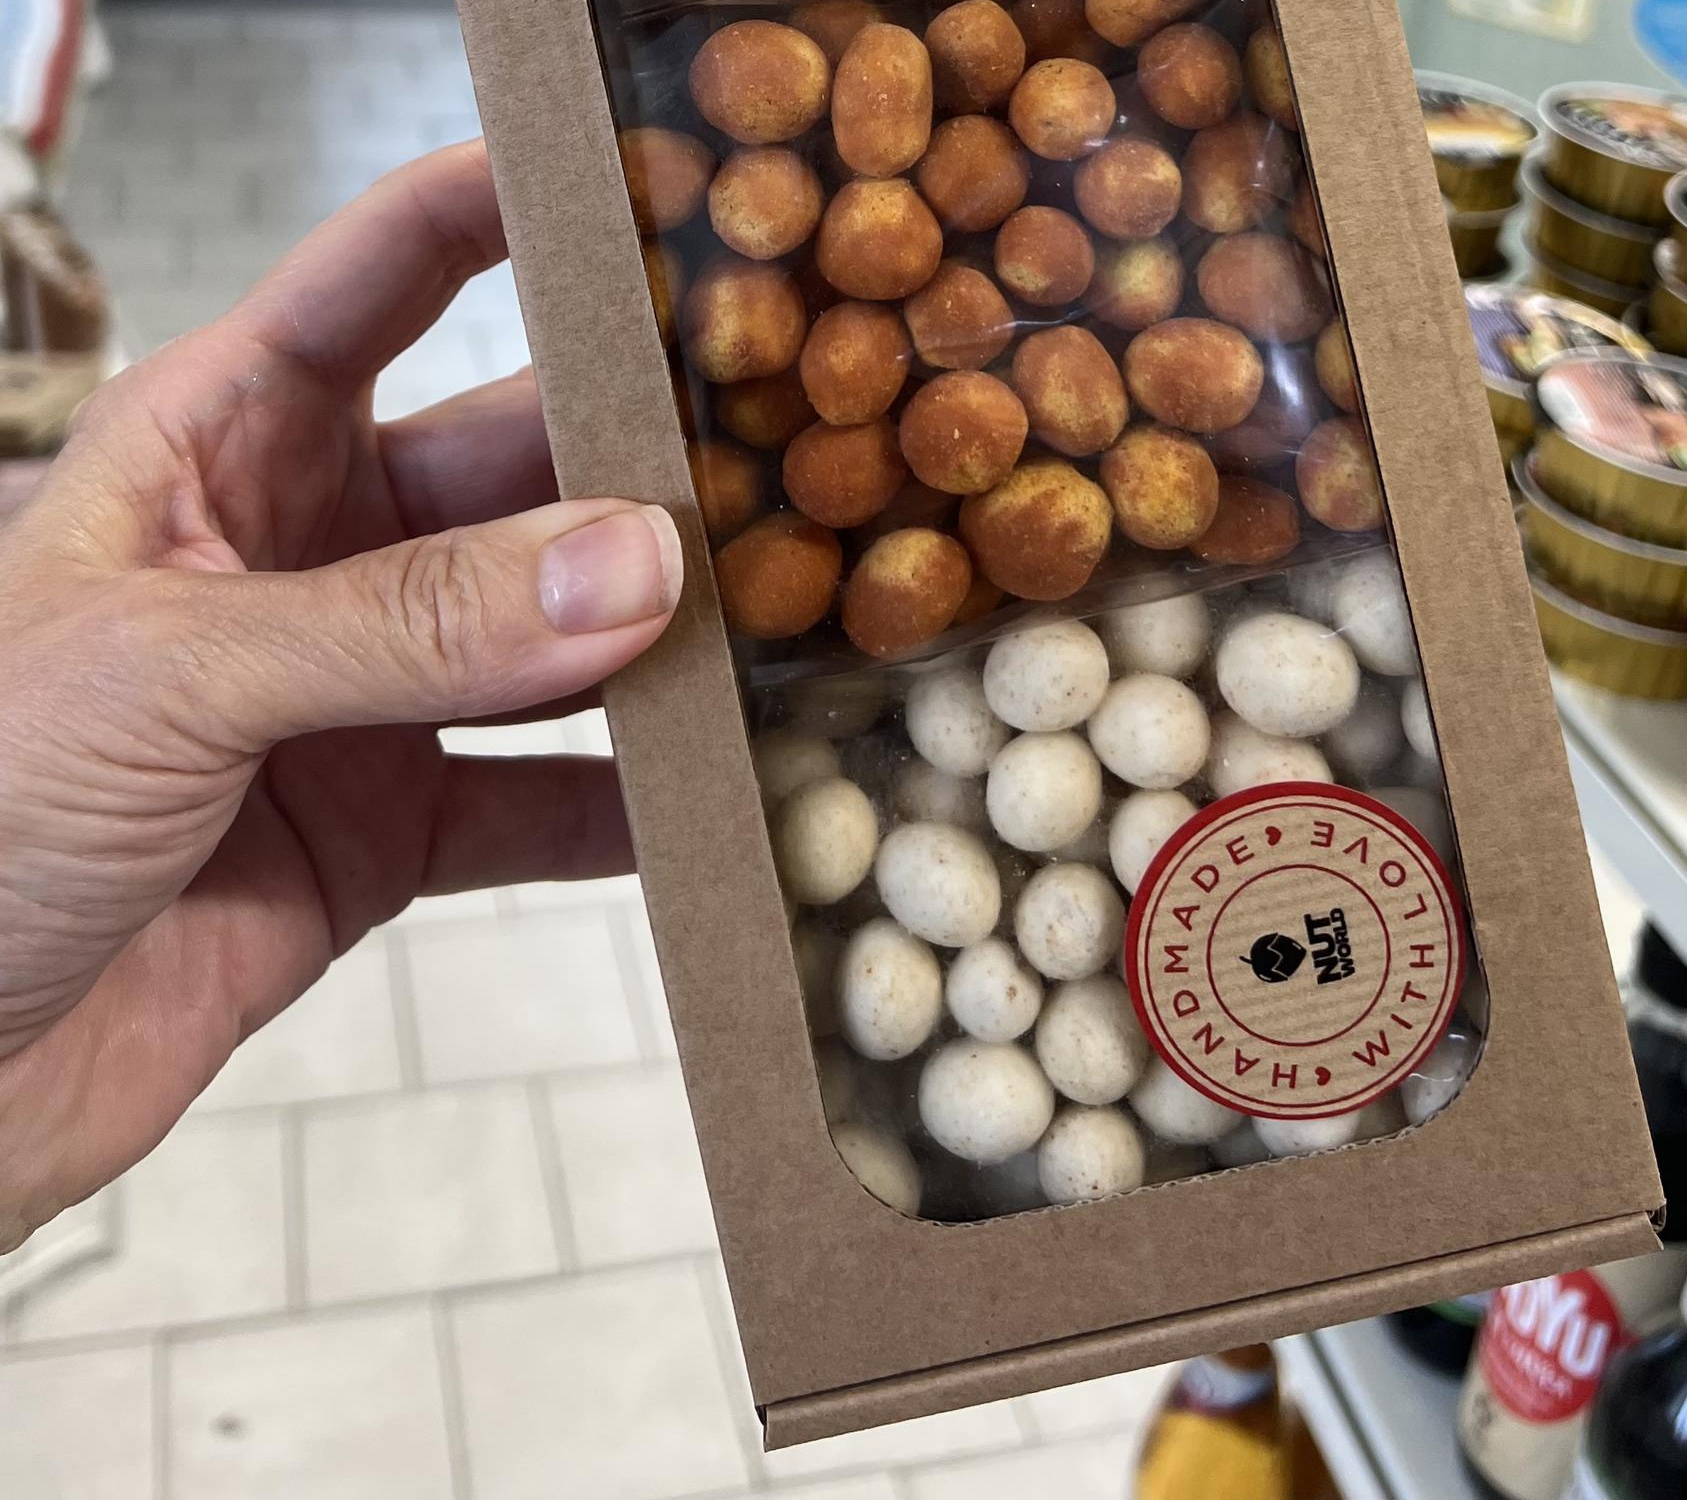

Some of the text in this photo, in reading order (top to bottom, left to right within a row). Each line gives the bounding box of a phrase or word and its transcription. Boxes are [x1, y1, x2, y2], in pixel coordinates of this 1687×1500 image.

[1163, 835, 1298, 1088] HANDMADE
[1304, 913, 1342, 985] NUT
[1310, 820, 1435, 1067] WITH LOVE
[1330, 908, 1356, 978] WORLD
[1503, 1276, 1610, 1377] OYU
